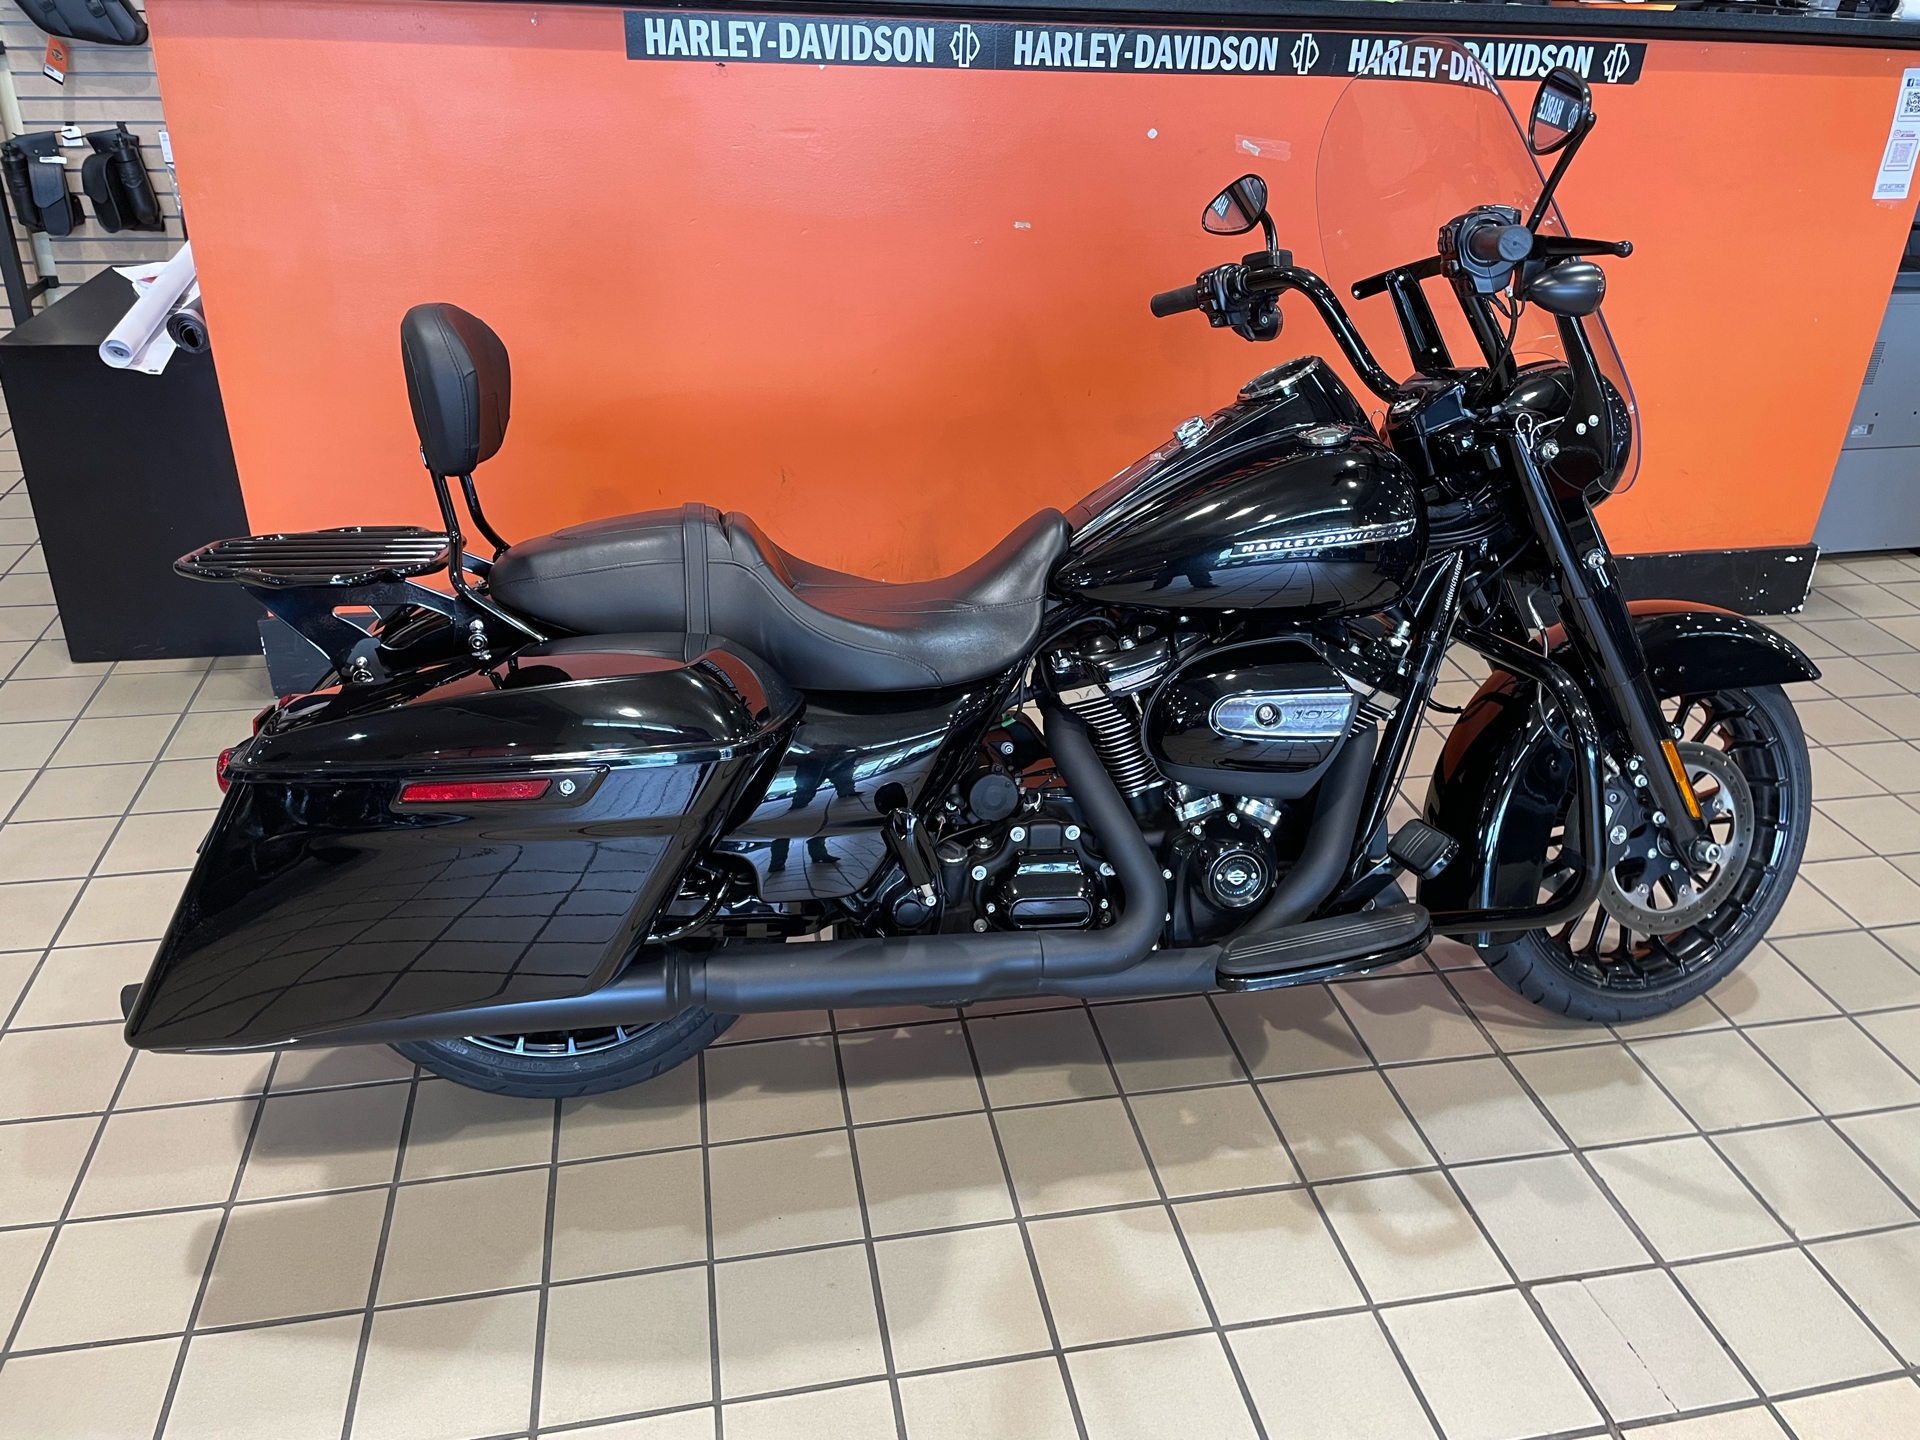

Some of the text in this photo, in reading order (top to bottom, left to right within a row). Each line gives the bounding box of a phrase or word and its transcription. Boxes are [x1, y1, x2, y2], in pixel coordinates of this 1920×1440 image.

[644, 18, 935, 63] HARLEY-DAVIDSON
[1013, 31, 1279, 71] HARLEY-DAVIDSON
[1347, 39, 1595, 80] HARLEY-DAVIDSON
[1241, 524, 1410, 554] HARLEY-DAVIDSON
[1292, 709, 1340, 720] 107
